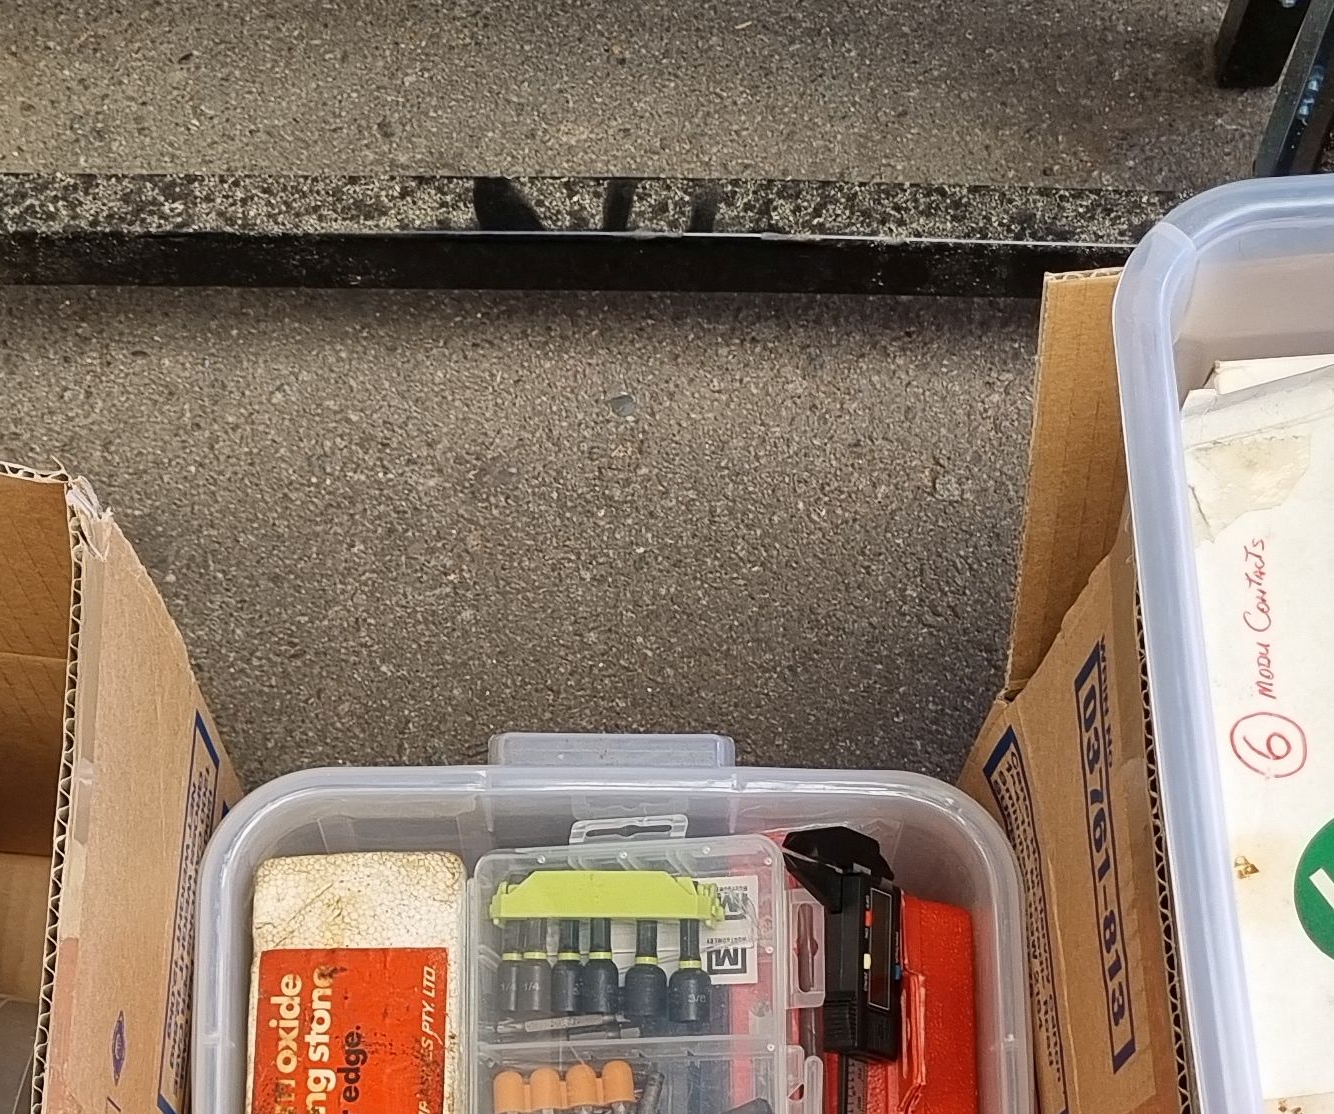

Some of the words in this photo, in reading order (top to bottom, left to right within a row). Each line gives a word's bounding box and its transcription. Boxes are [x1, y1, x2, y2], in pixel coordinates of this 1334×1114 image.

[1083, 686, 1127, 1027] 03761-813
[268, 973, 303, 1073] oxide
[337, 1025, 367, 1103] edge.
